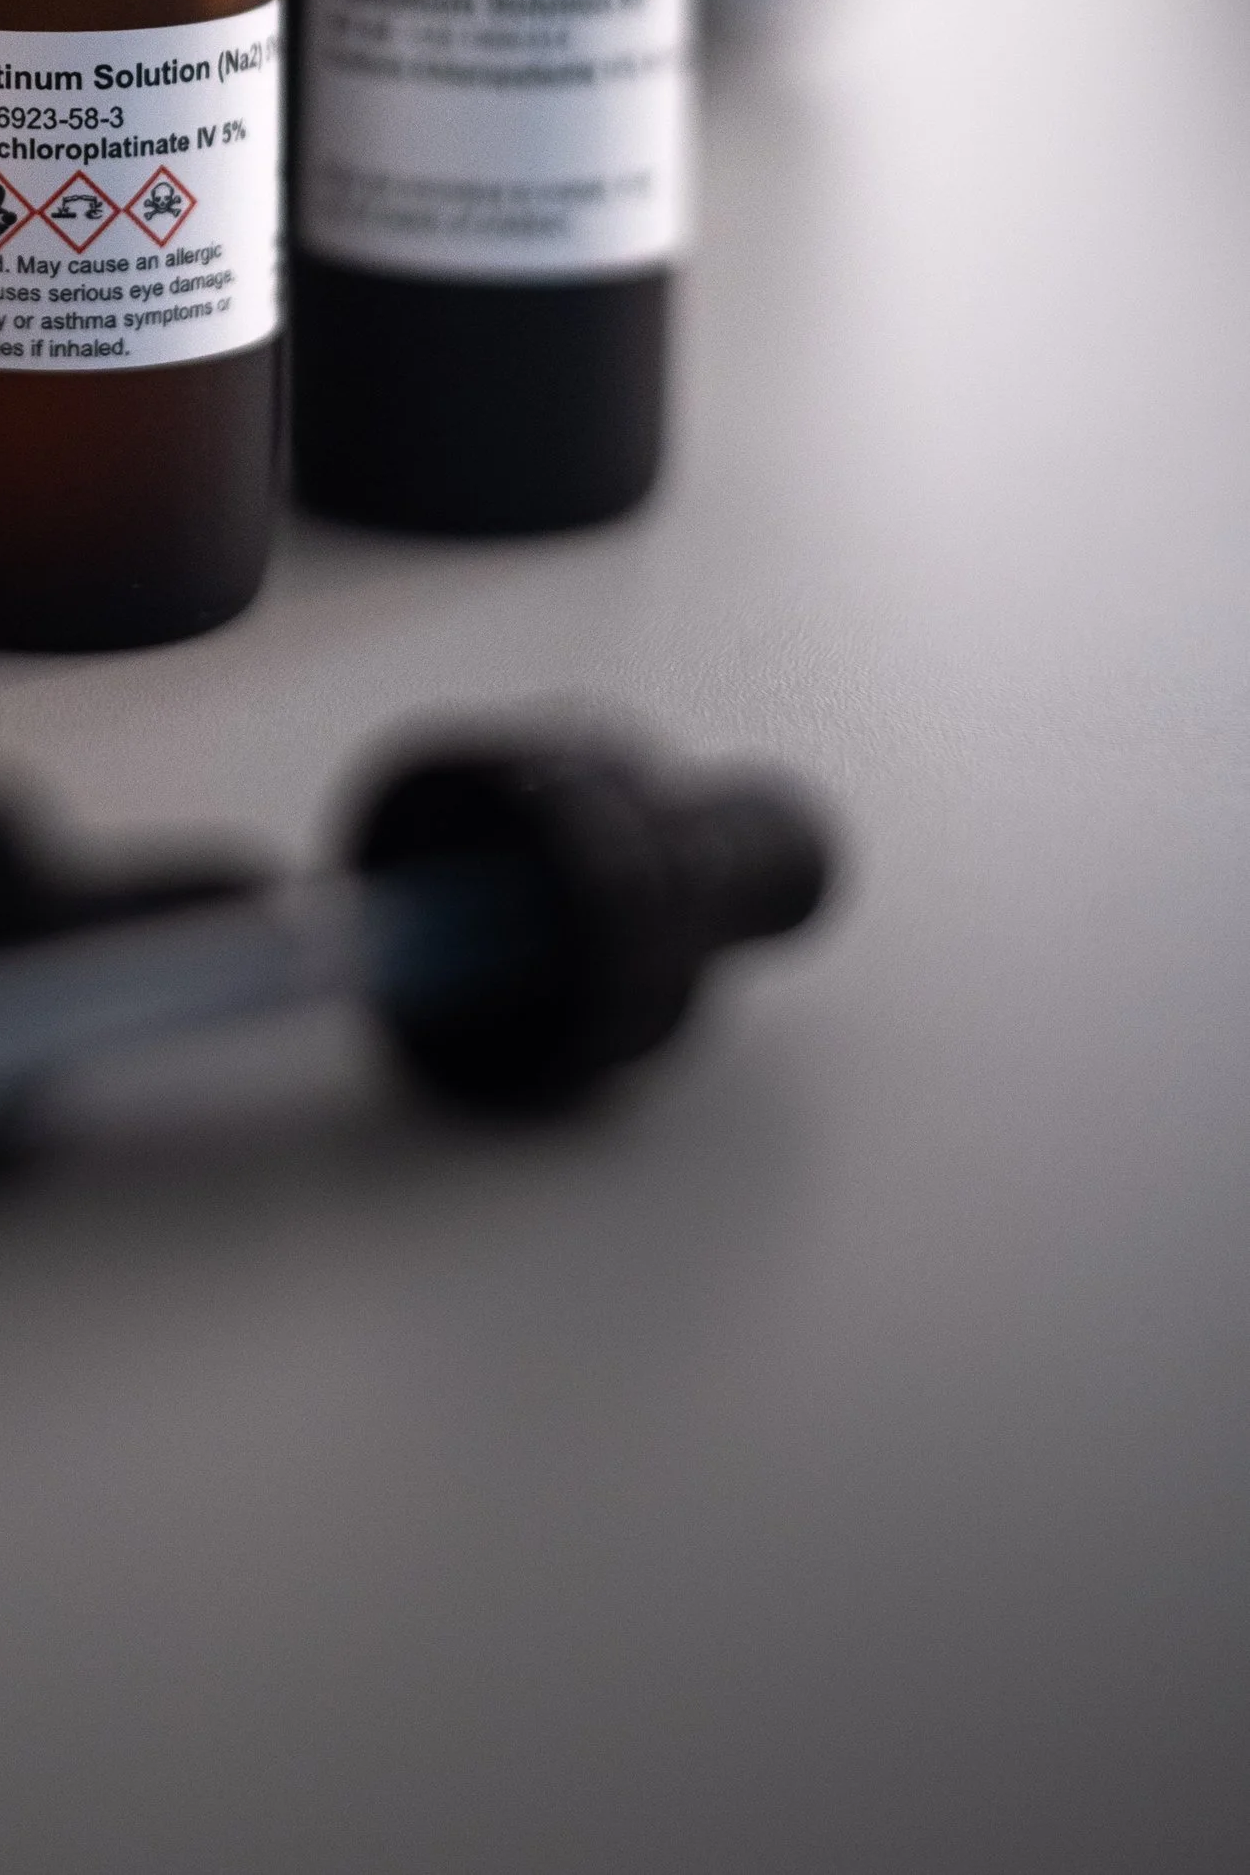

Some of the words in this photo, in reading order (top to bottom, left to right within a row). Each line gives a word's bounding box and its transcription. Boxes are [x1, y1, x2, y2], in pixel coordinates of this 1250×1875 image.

[93, 59, 211, 91] Solution
[217, 42, 263, 84] (Na2)
[196, 126, 217, 148] IV
[221, 118, 247, 145] 5%
[17, 255, 61, 278] May
[67, 256, 130, 274] cause
[135, 255, 160, 271] an
[164, 241, 223, 267] allergic
[47, 282, 124, 303] serious
[129, 282, 164, 305] eye
[169, 267, 236, 296] damage.
[13, 314, 35, 330] or
[40, 308, 116, 331] asthma
[123, 298, 212, 329] symptoms
[216, 295, 231, 311] or
[30, 338, 45, 357] if
[48, 338, 131, 358] inhaled.
